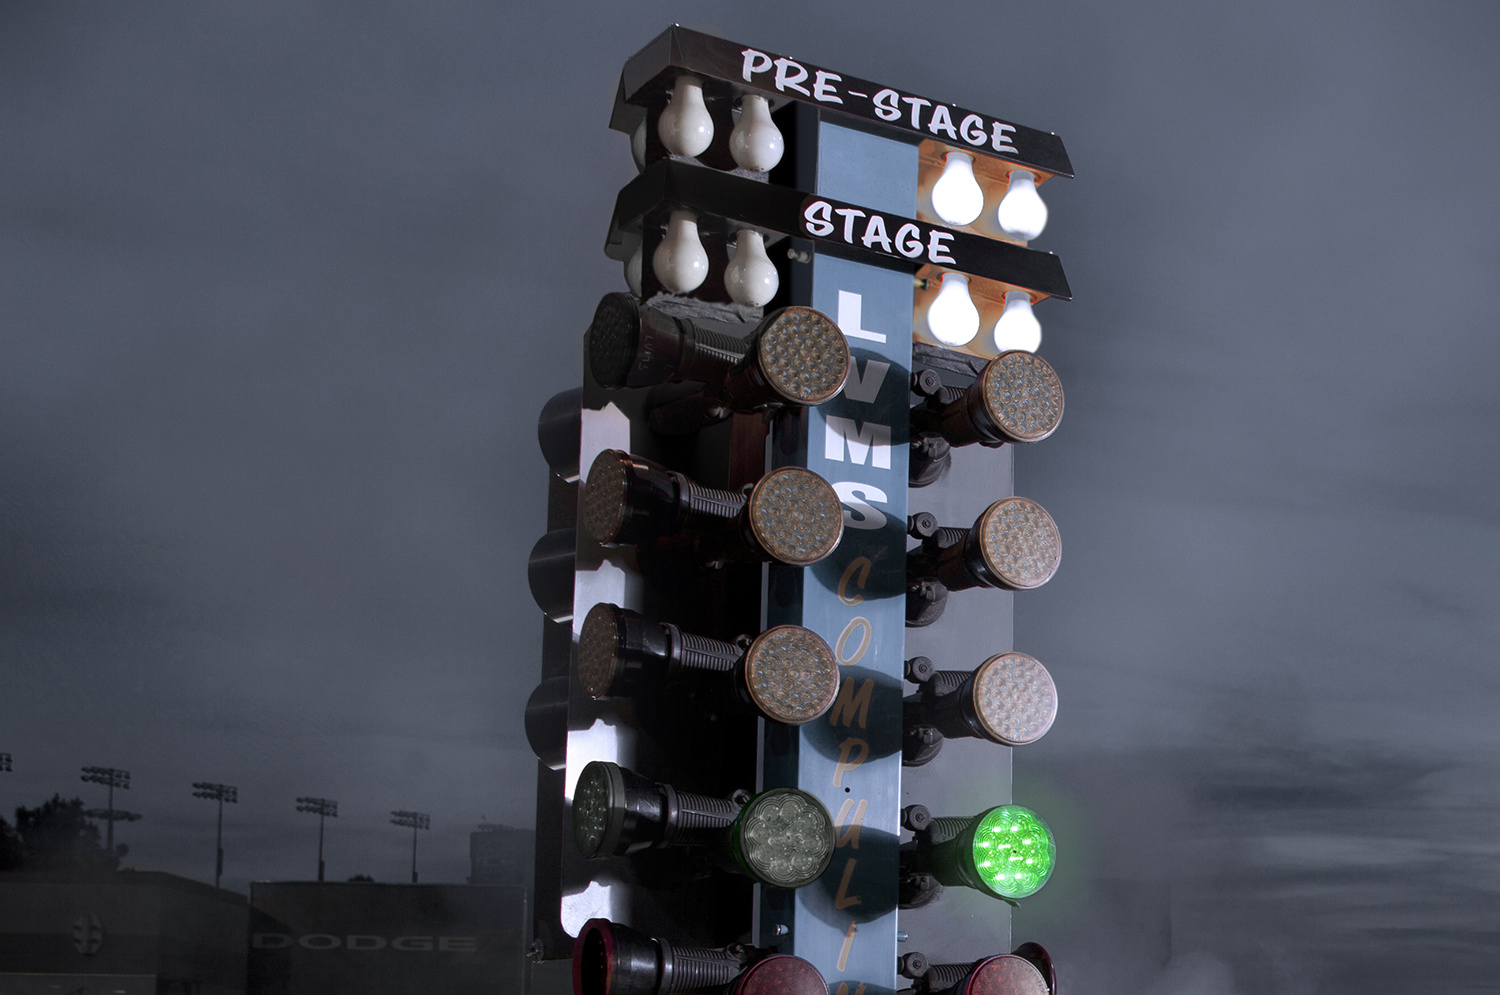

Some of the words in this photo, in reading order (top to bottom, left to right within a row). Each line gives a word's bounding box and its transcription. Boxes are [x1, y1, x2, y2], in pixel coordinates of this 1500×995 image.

[741, 48, 1019, 154] PRE-STAGE
[804, 200, 957, 265] STAGE
[251, 932, 478, 951] DODGE
